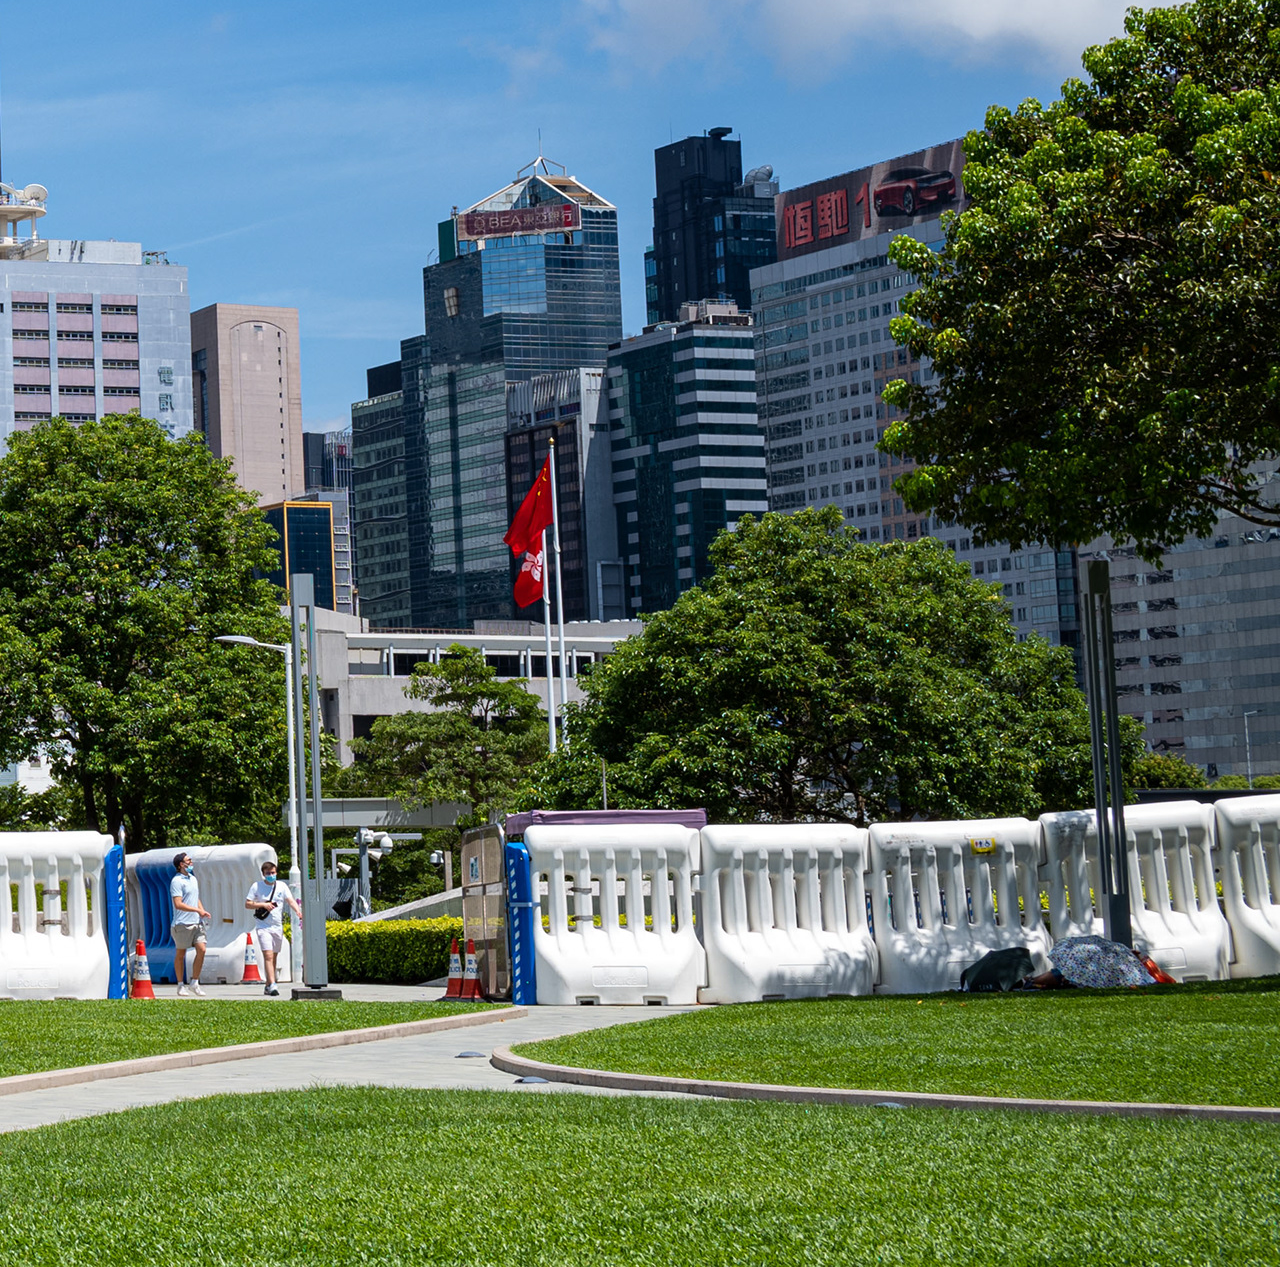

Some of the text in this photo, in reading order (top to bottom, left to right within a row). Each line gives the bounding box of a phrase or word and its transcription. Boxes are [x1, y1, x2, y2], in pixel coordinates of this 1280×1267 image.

[489, 211, 572, 228] BEA 東亞銀行
